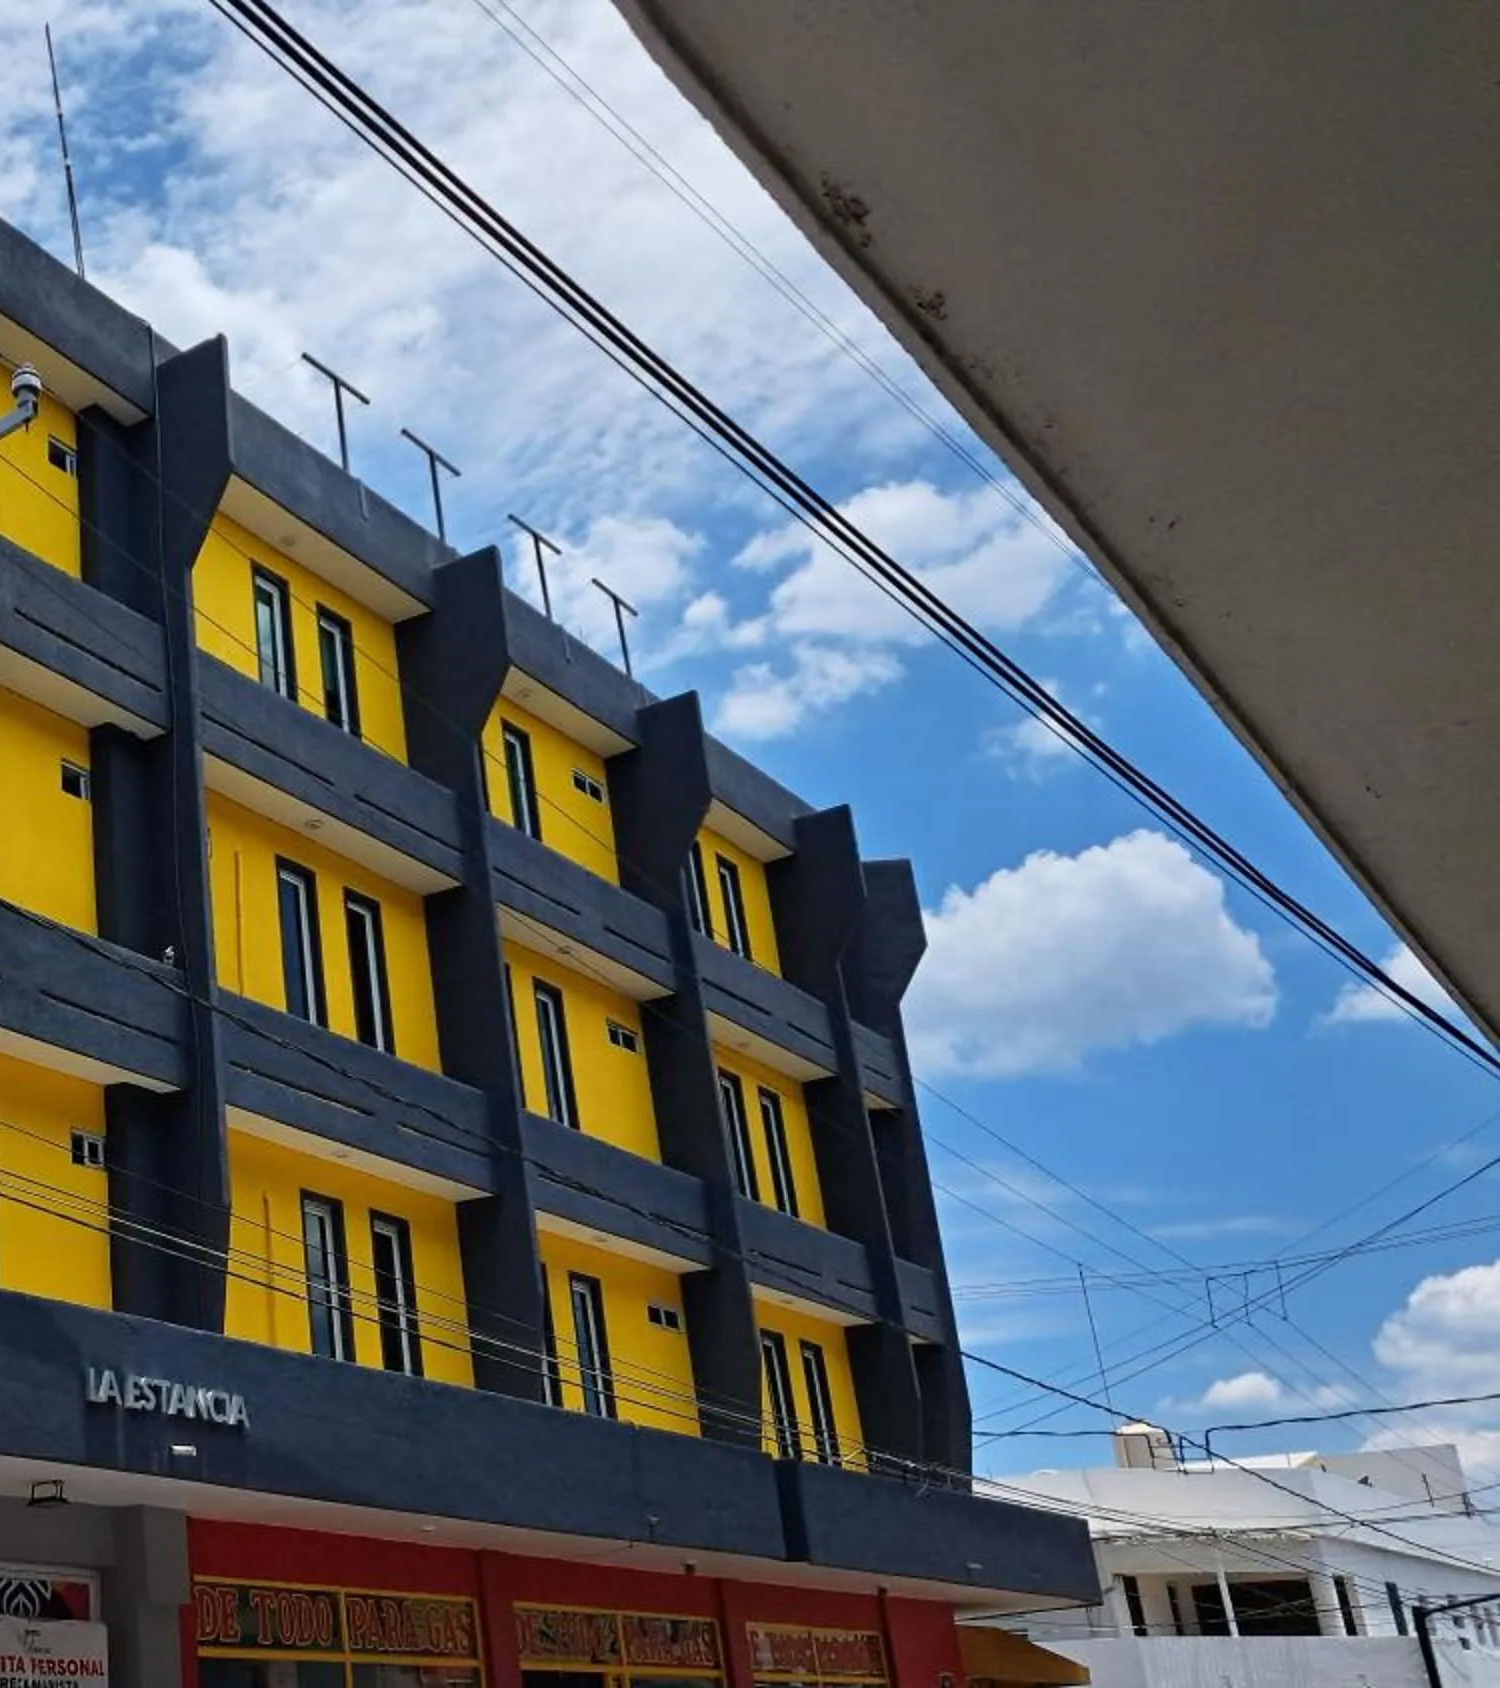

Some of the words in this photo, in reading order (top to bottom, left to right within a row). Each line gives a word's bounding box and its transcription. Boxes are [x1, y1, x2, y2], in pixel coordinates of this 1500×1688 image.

[87, 1367, 122, 1406] LA
[124, 1375, 250, 1429] ESTANCIA
[194, 1586, 240, 1643] DE
[250, 1590, 333, 1647] TODO
[348, 1597, 423, 1651] PARA
[31, 1657, 105, 1677] PERSONAL
